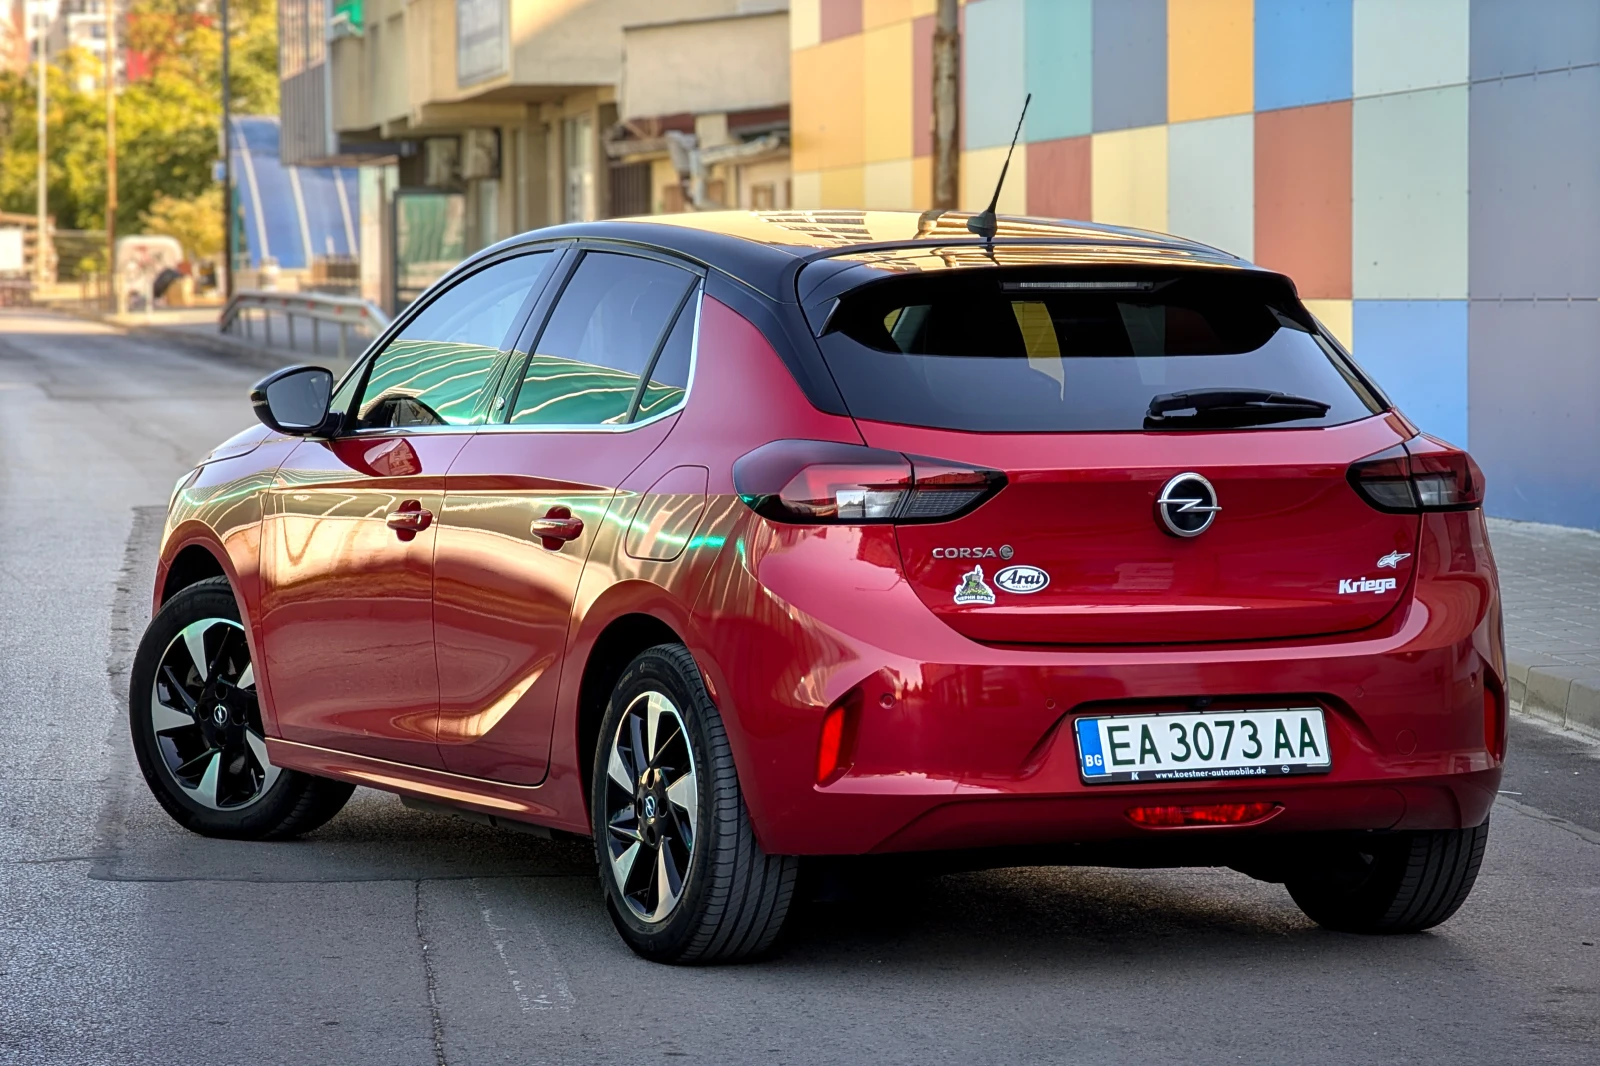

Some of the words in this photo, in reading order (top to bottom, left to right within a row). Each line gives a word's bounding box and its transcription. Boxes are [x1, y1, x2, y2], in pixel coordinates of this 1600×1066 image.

[932, 547, 997, 559] CORSA
[999, 569, 1042, 585] Arai
[1338, 577, 1397, 594] Kriega
[1107, 723, 1162, 766] EA
[1169, 719, 1263, 763] 3073
[1274, 717, 1321, 759] AA
[1085, 754, 1103, 767] BG
[1131, 771, 1140, 780] K
[1155, 766, 1267, 779] www.koestner-automobile.de
